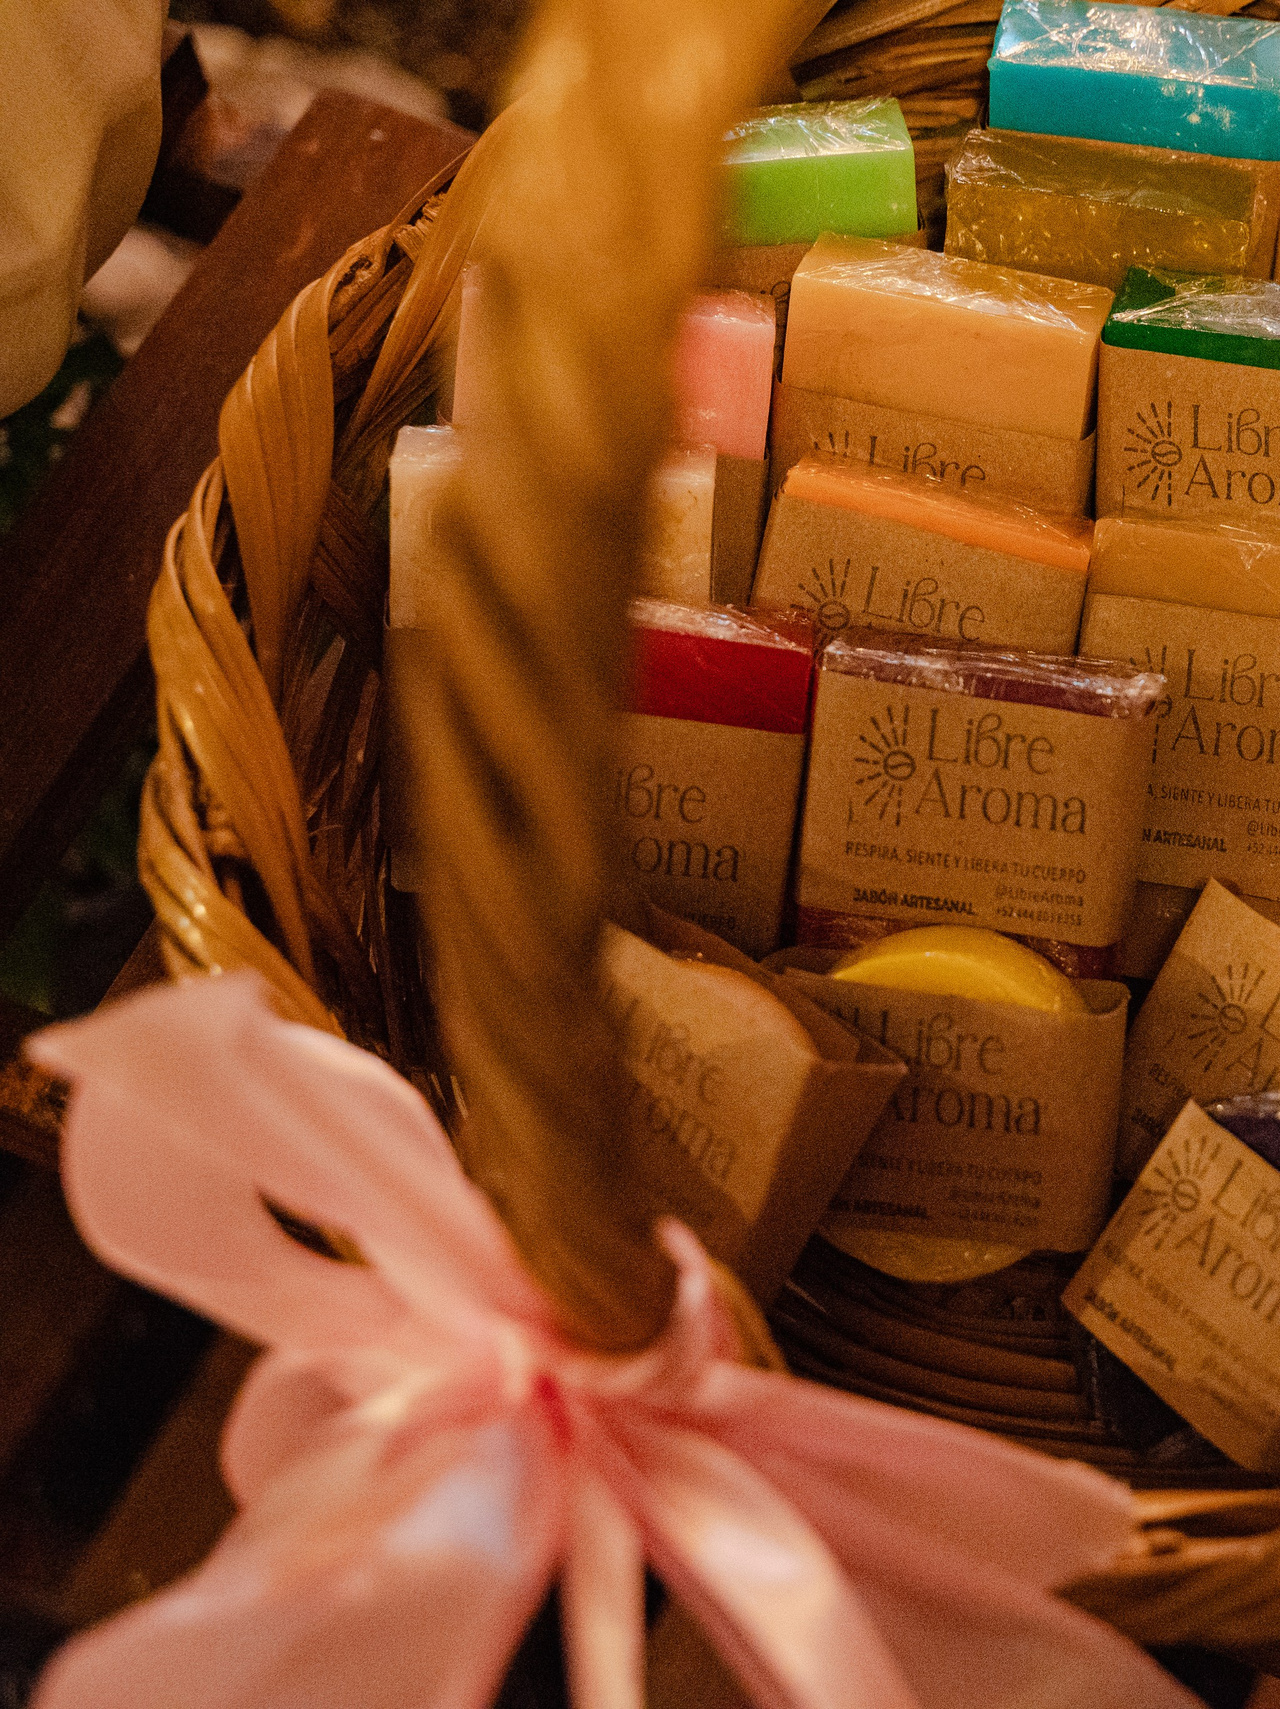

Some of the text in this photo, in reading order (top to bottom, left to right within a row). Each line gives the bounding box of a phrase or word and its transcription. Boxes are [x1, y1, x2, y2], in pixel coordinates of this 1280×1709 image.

[861, 566, 985, 642] Libre
[926, 706, 1054, 775] Libre
[614, 763, 707, 824] ibre
[915, 767, 1087, 835] Aroma
[1161, 785, 1204, 804] SIENTE
[1206, 792, 1215, 804] Y
[1217, 794, 1261, 813] LIBERA
[1263, 799, 1280, 814] TU
[632, 837, 740, 882] oma
[906, 849, 950, 868] SIENTE
